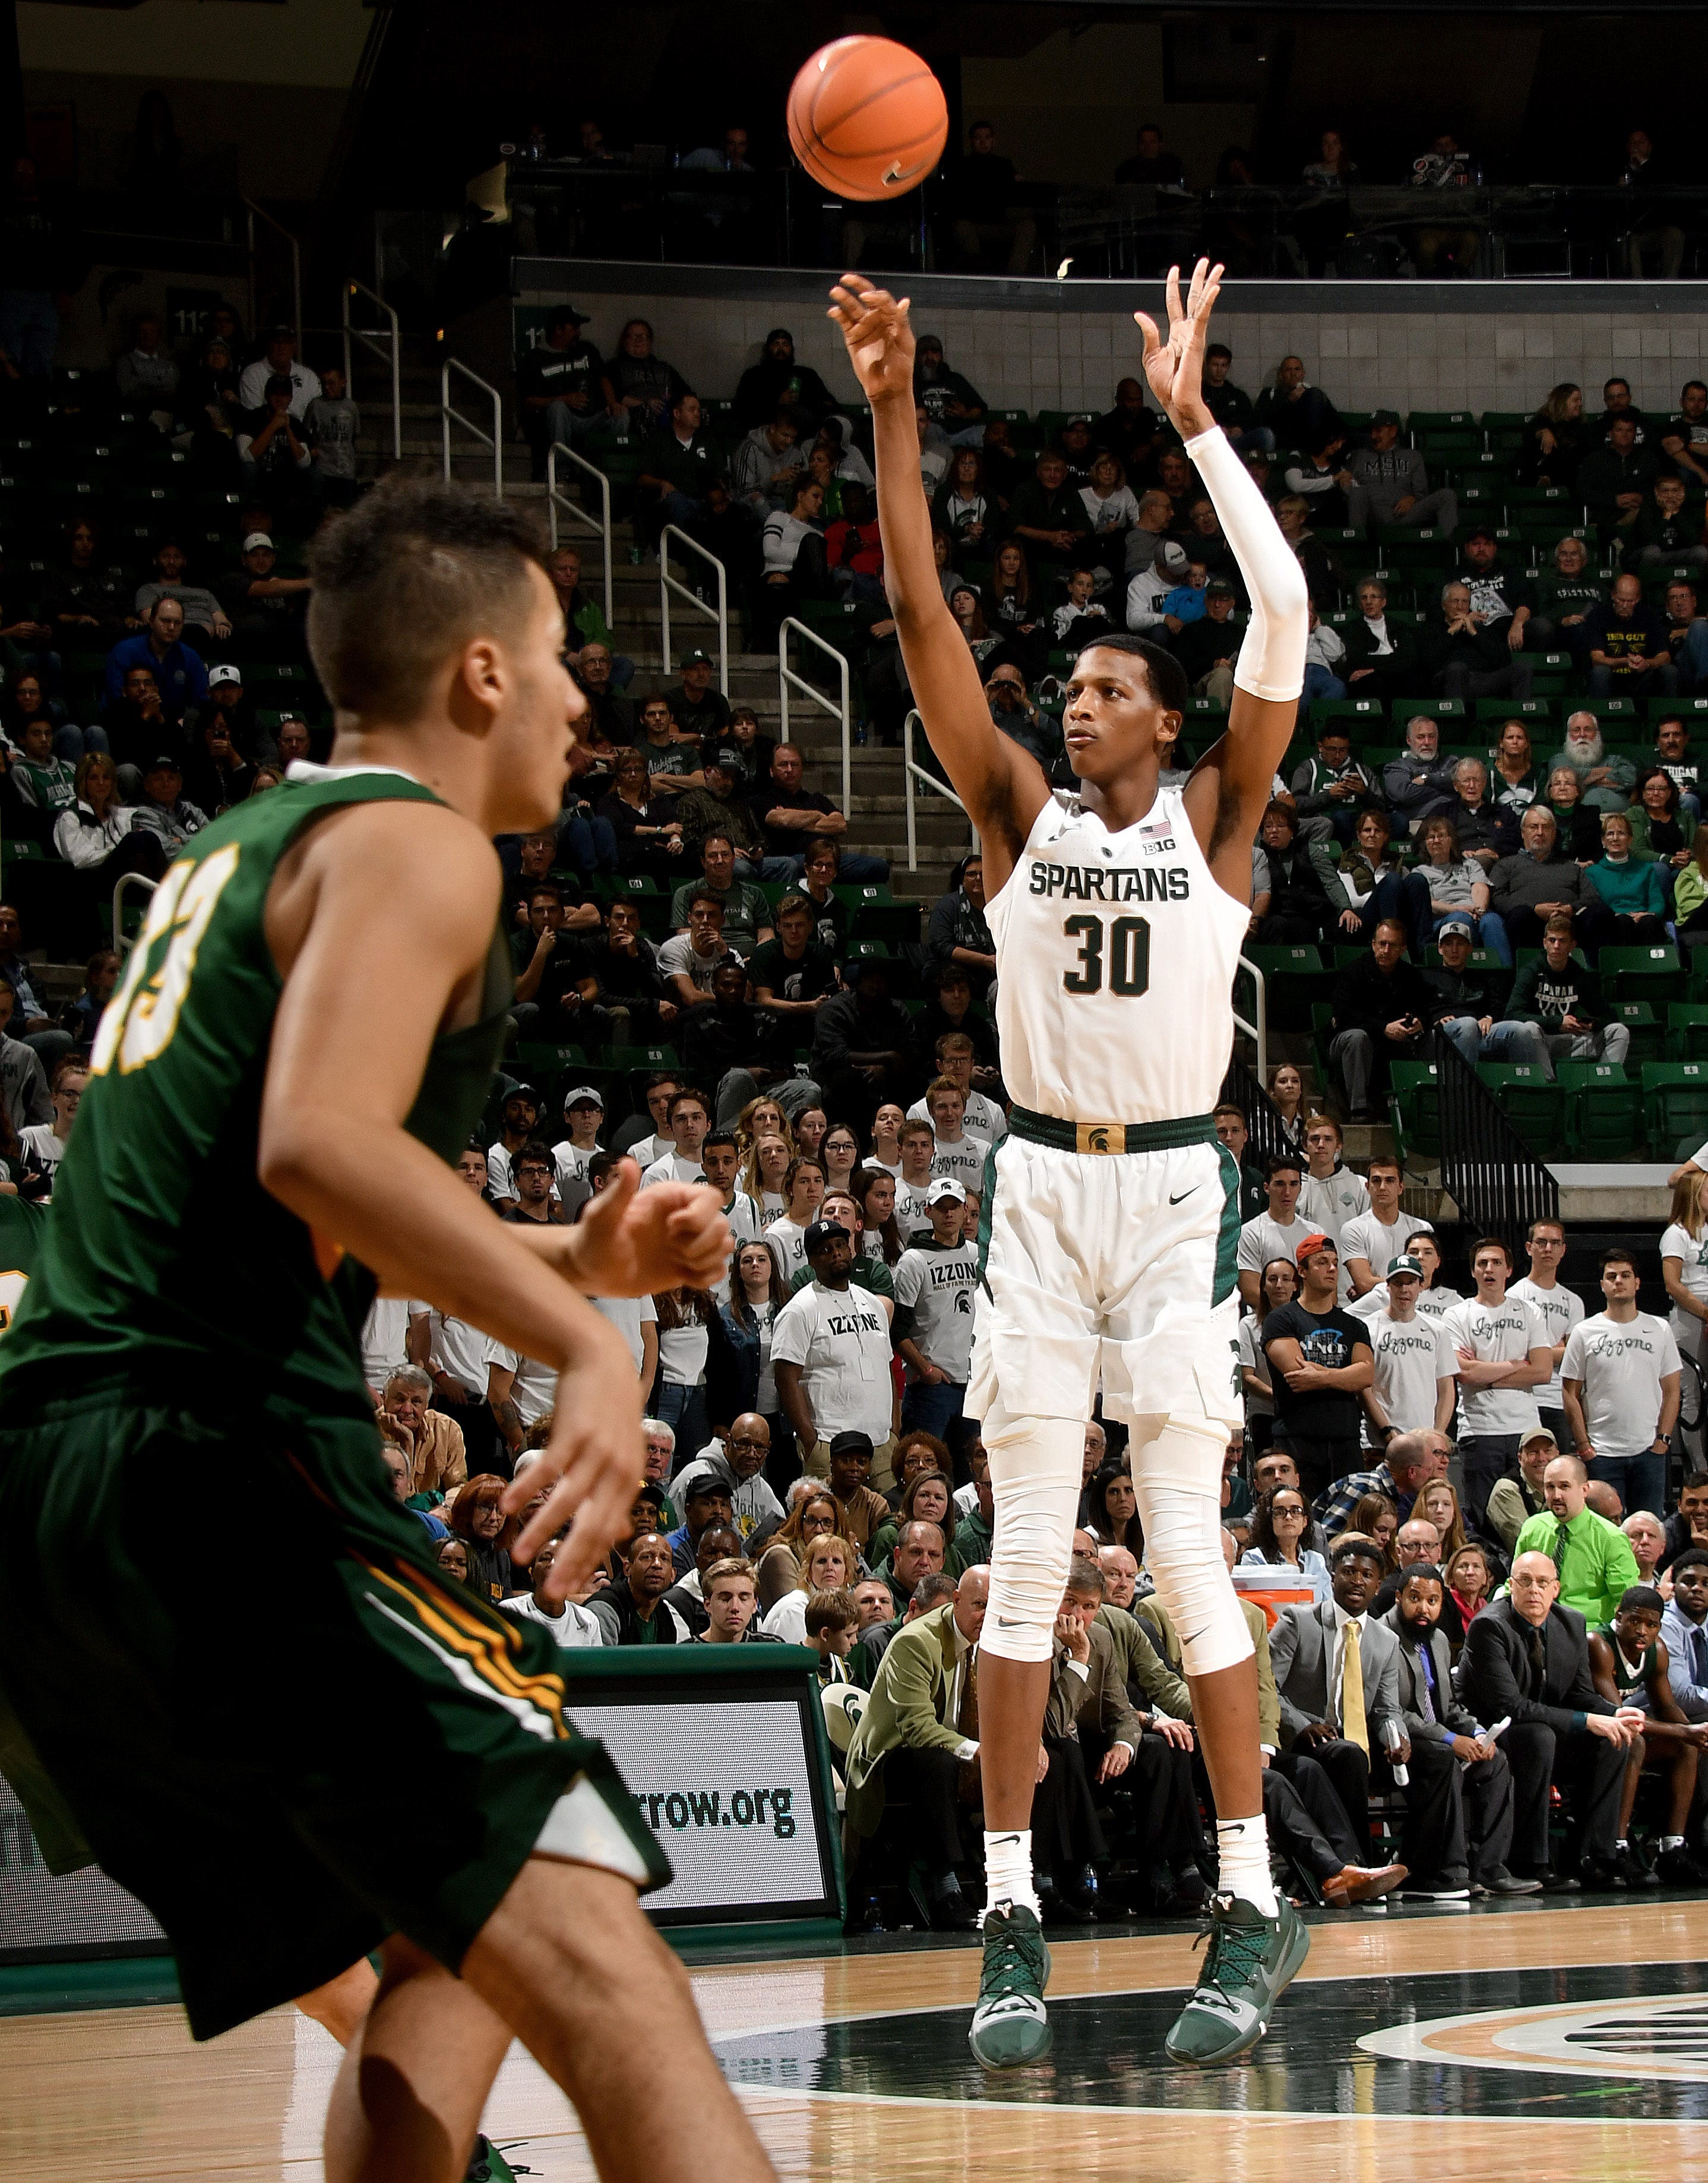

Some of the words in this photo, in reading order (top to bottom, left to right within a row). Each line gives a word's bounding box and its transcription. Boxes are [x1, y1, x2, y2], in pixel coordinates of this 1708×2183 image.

[1029, 862, 1189, 902] SPARTANS
[1062, 914, 1151, 997] 30
[1380, 1332, 1433, 1354] Izzone
[1593, 1334, 1655, 1356] Izzone
